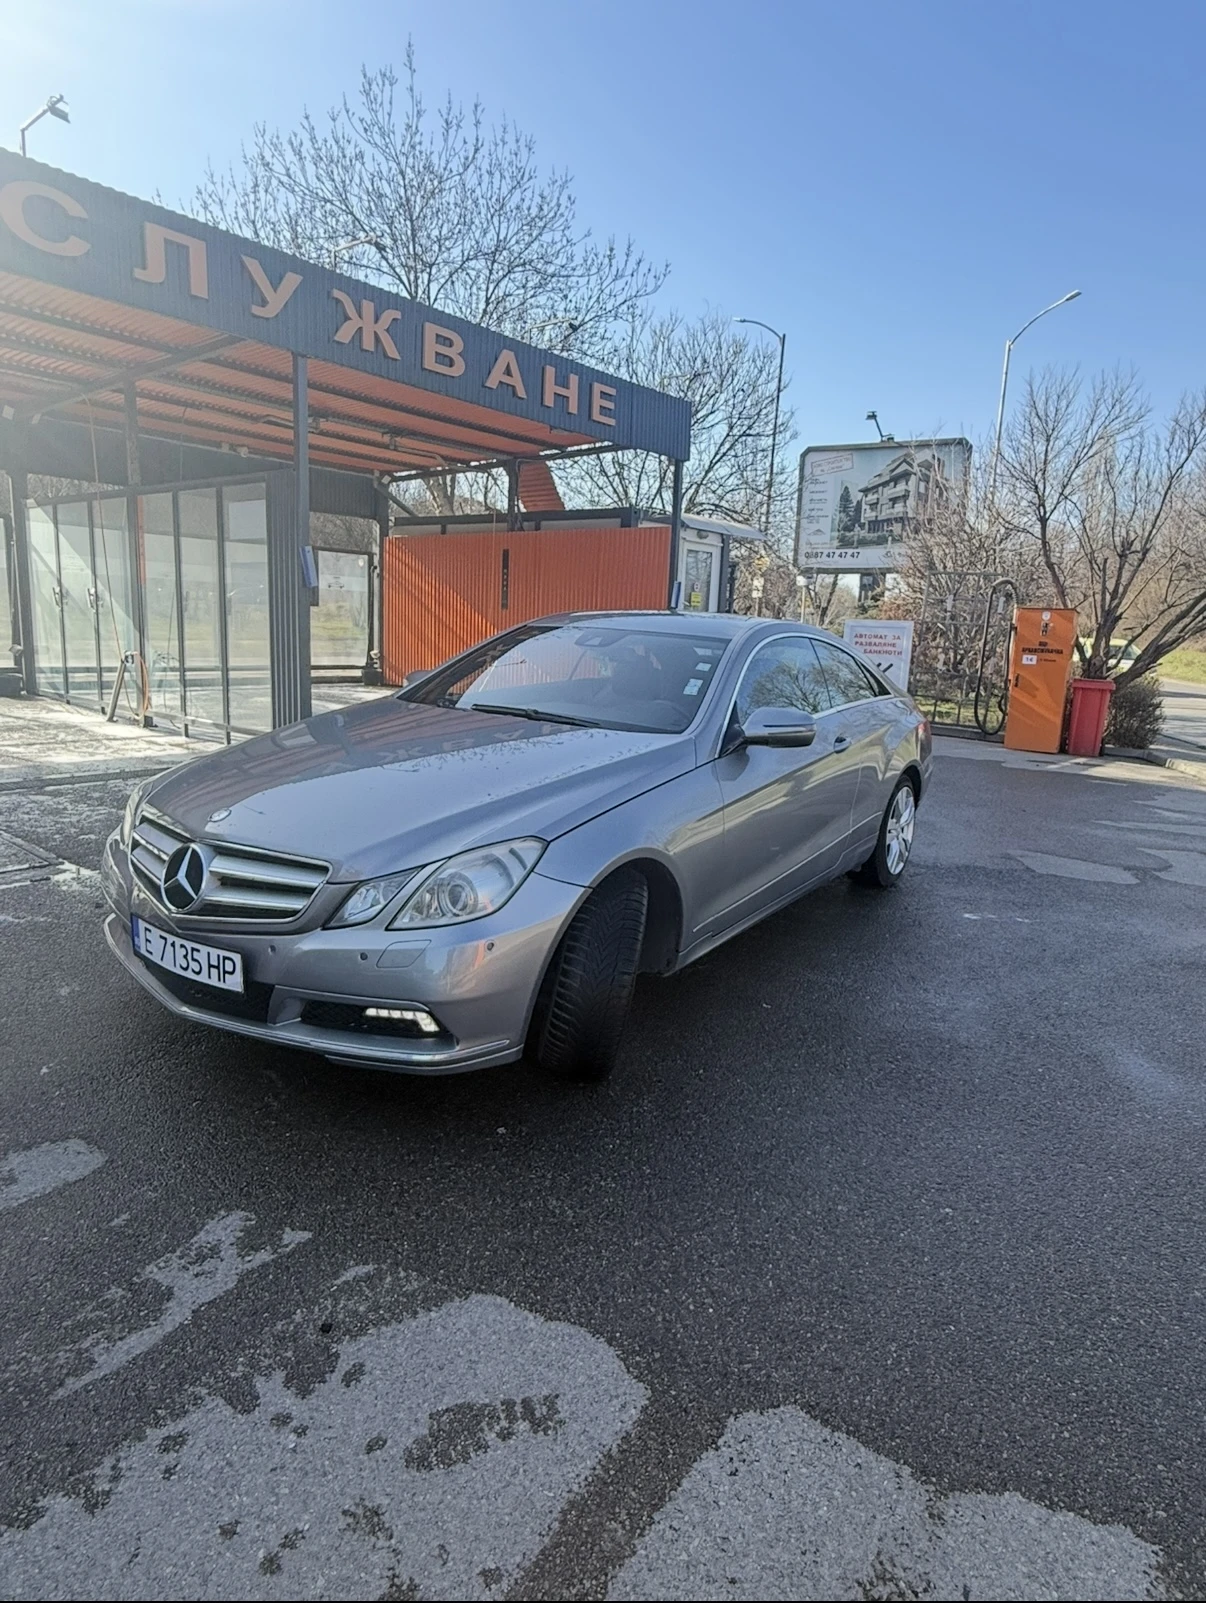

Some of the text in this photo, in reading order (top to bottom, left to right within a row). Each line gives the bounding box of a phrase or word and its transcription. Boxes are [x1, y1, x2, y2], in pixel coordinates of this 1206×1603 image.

[0, 180, 617, 426] СЛУЖВАНЕ
[826, 551, 836, 559] 47
[838, 551, 848, 559] 47
[850, 551, 860, 559] 47
[144, 926, 237, 984] E 7135 HP
